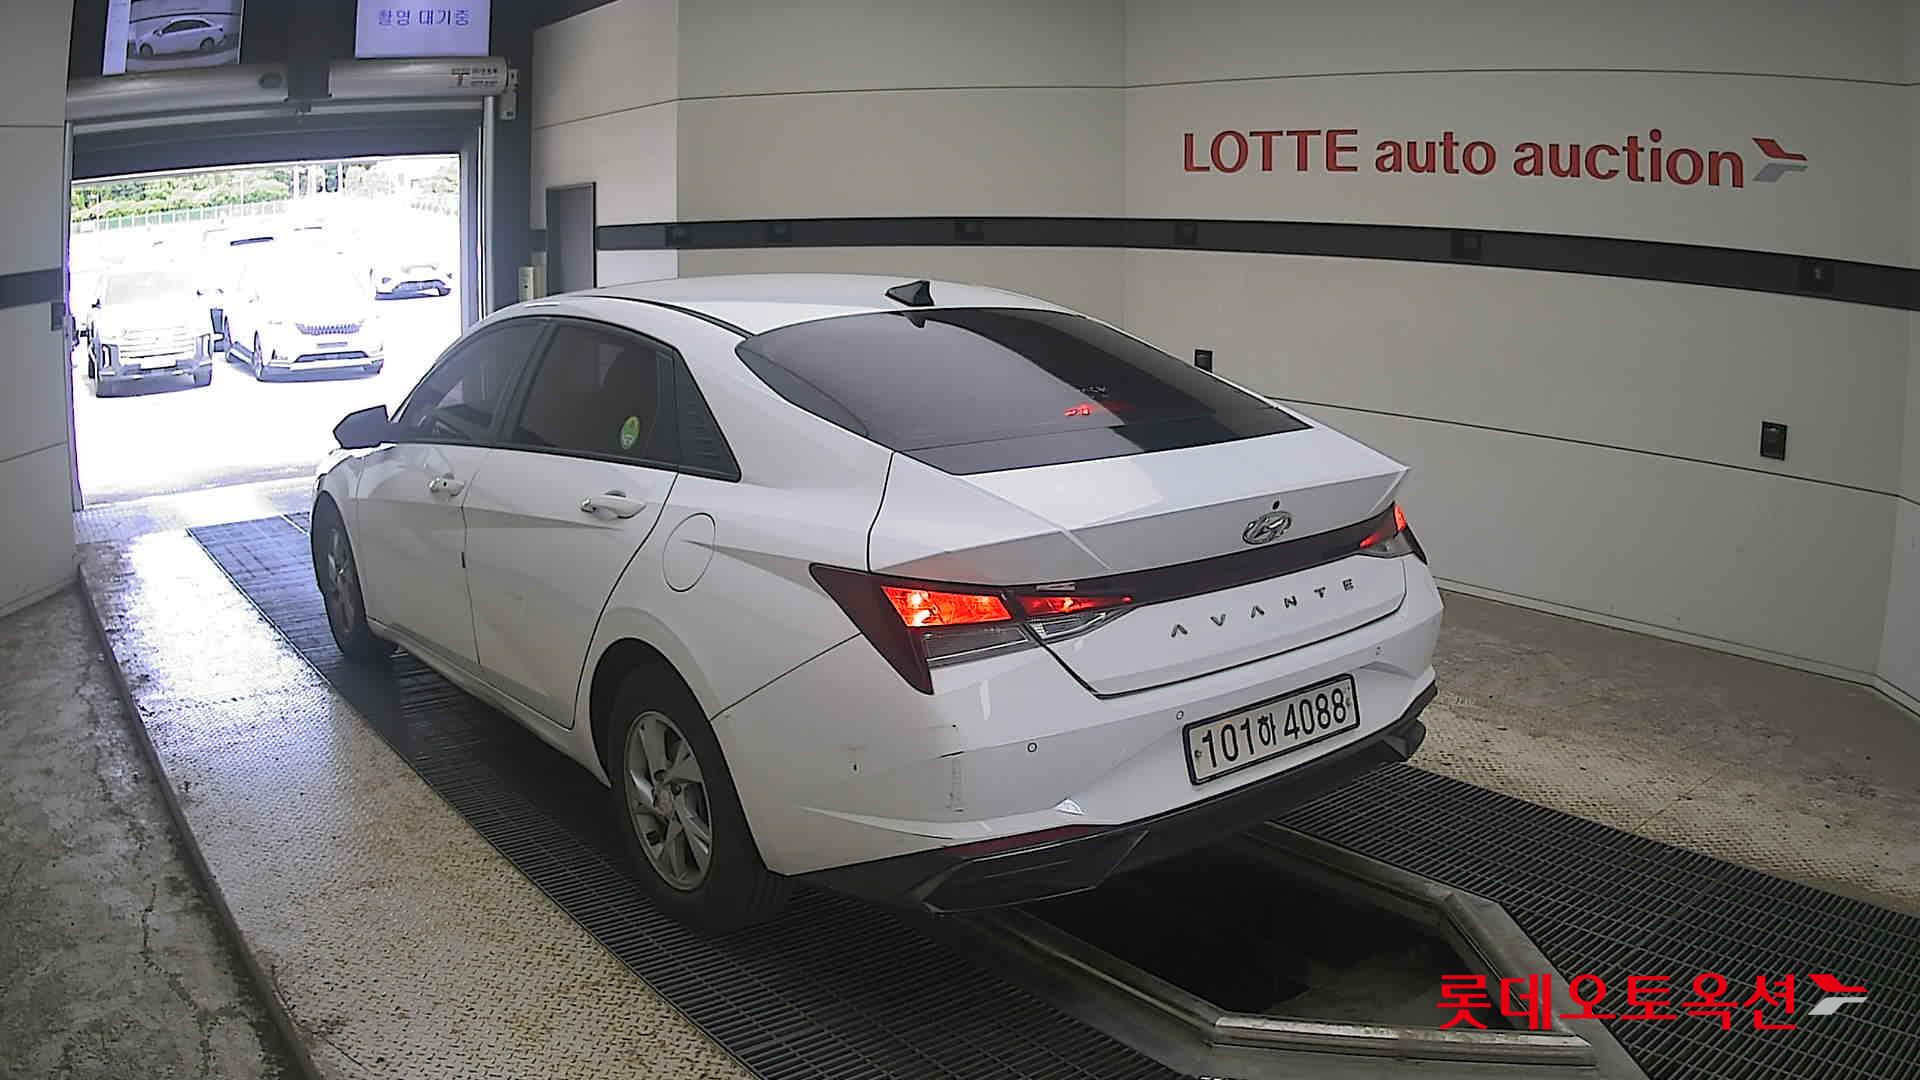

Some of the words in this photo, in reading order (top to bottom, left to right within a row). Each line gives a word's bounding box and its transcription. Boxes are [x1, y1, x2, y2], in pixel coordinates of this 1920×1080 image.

[419, 8, 470, 26] 대기중
[1183, 128, 1359, 173] LOTTE
[1374, 131, 1497, 176] auto
[1513, 128, 1744, 189] auction
[1170, 578, 1355, 638] AVANTE
[1283, 687, 1347, 740] 4088
